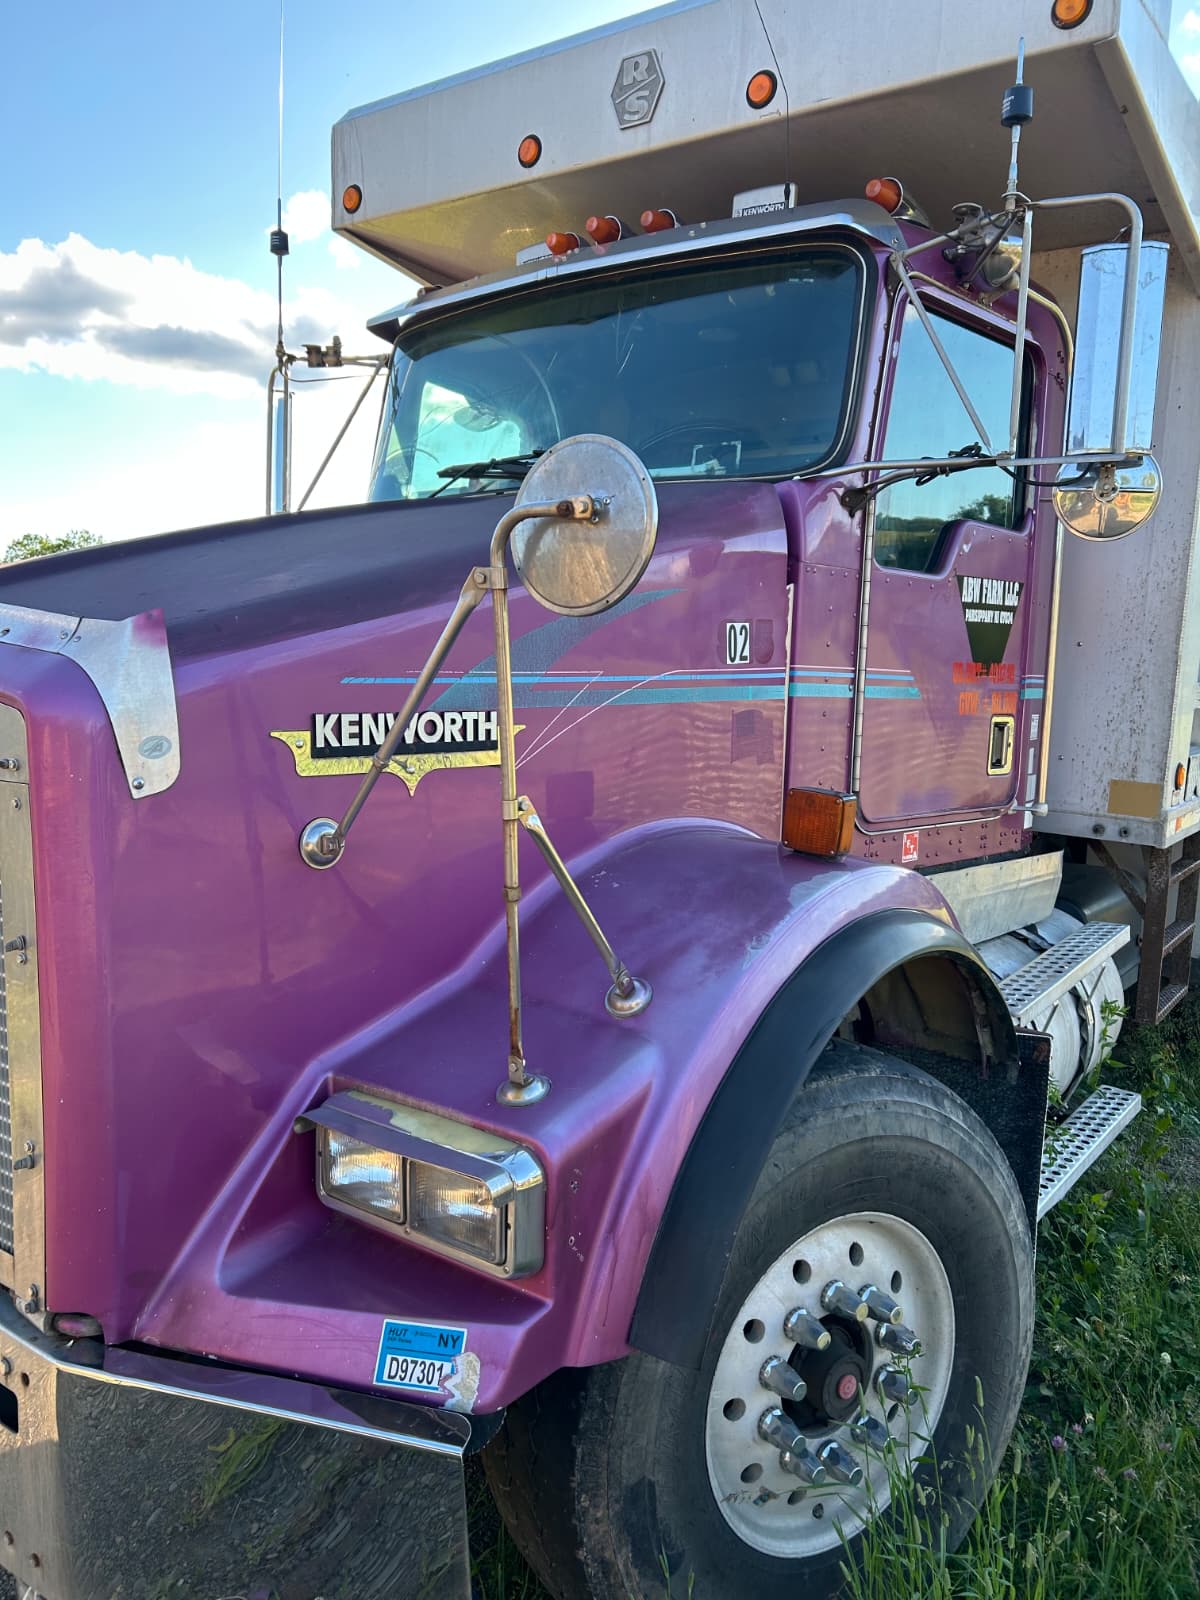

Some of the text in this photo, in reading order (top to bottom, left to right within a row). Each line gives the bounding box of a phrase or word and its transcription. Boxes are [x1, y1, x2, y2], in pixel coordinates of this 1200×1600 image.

[742, 202, 785, 217] KENWORTH
[962, 576, 1020, 606] ABW FARM LLC
[728, 624, 748, 663] 02
[314, 711, 498, 748] KENWORTH
[388, 1327, 408, 1336] HUT
[438, 1333, 461, 1349] NY
[387, 1356, 444, 1386] D97301
